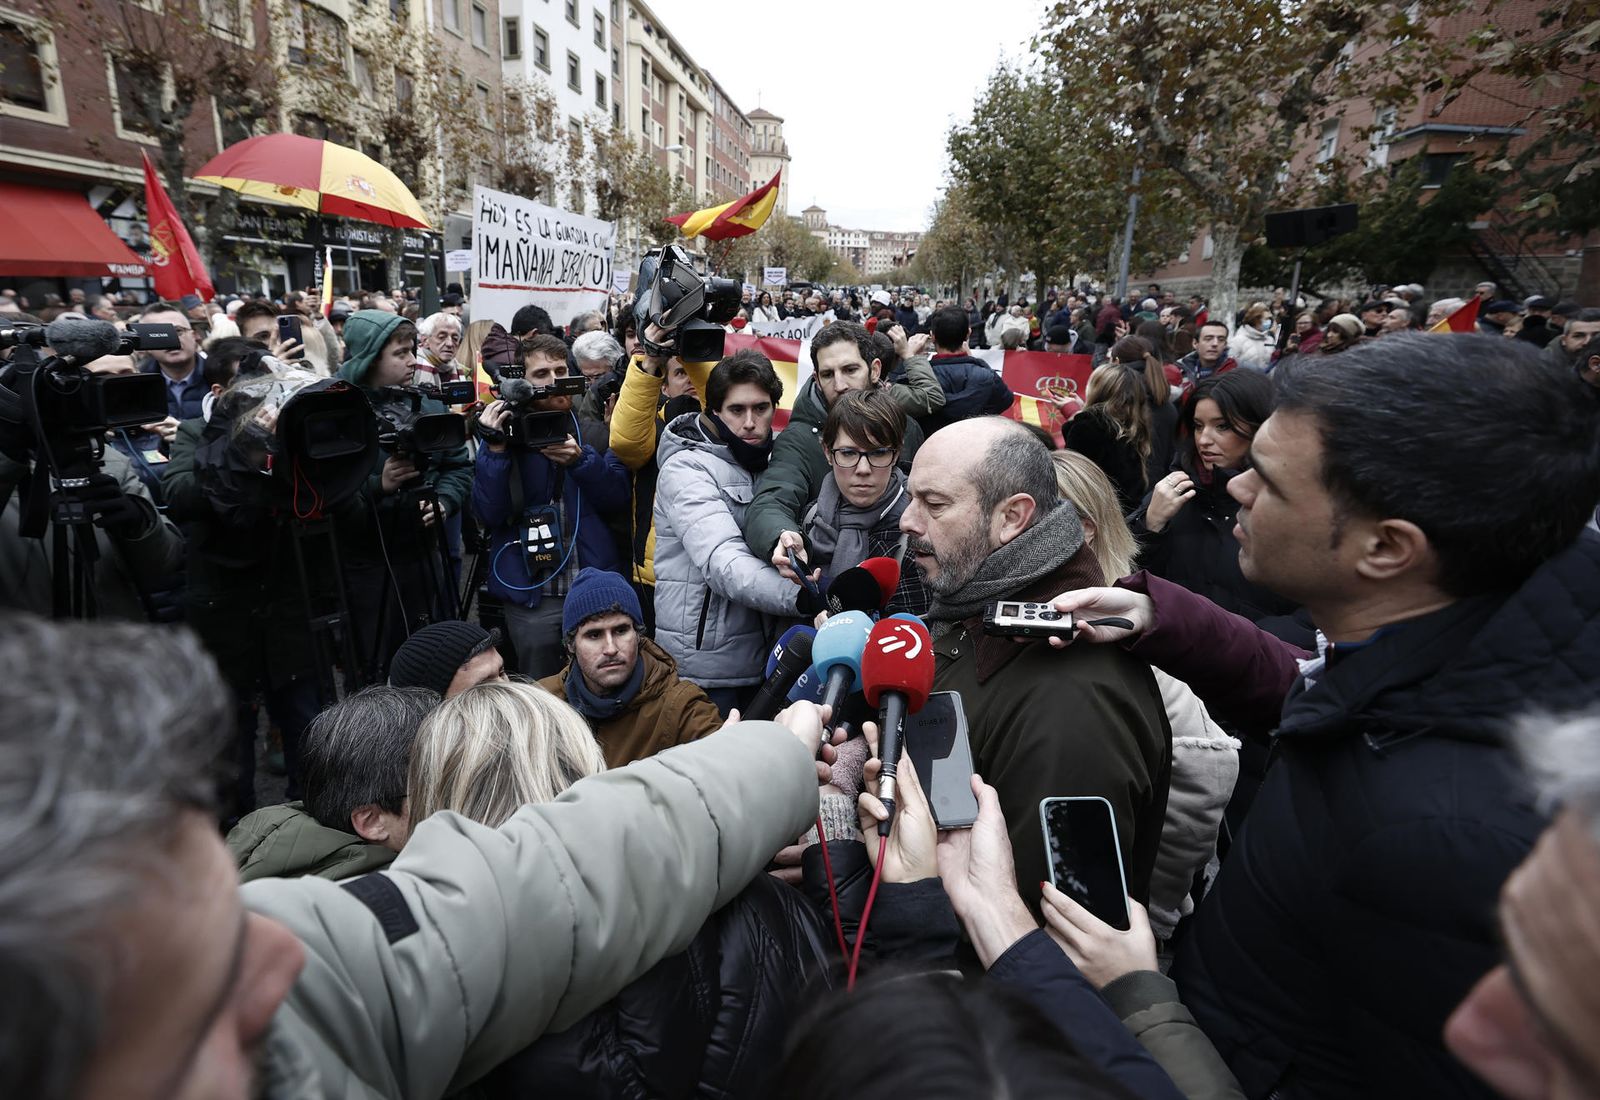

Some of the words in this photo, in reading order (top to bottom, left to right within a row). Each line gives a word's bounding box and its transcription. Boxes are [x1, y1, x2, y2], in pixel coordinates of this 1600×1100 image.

[515, 208, 532, 236] ES
[537, 217, 552, 240] LA
[555, 221, 590, 247] GUARDIA
